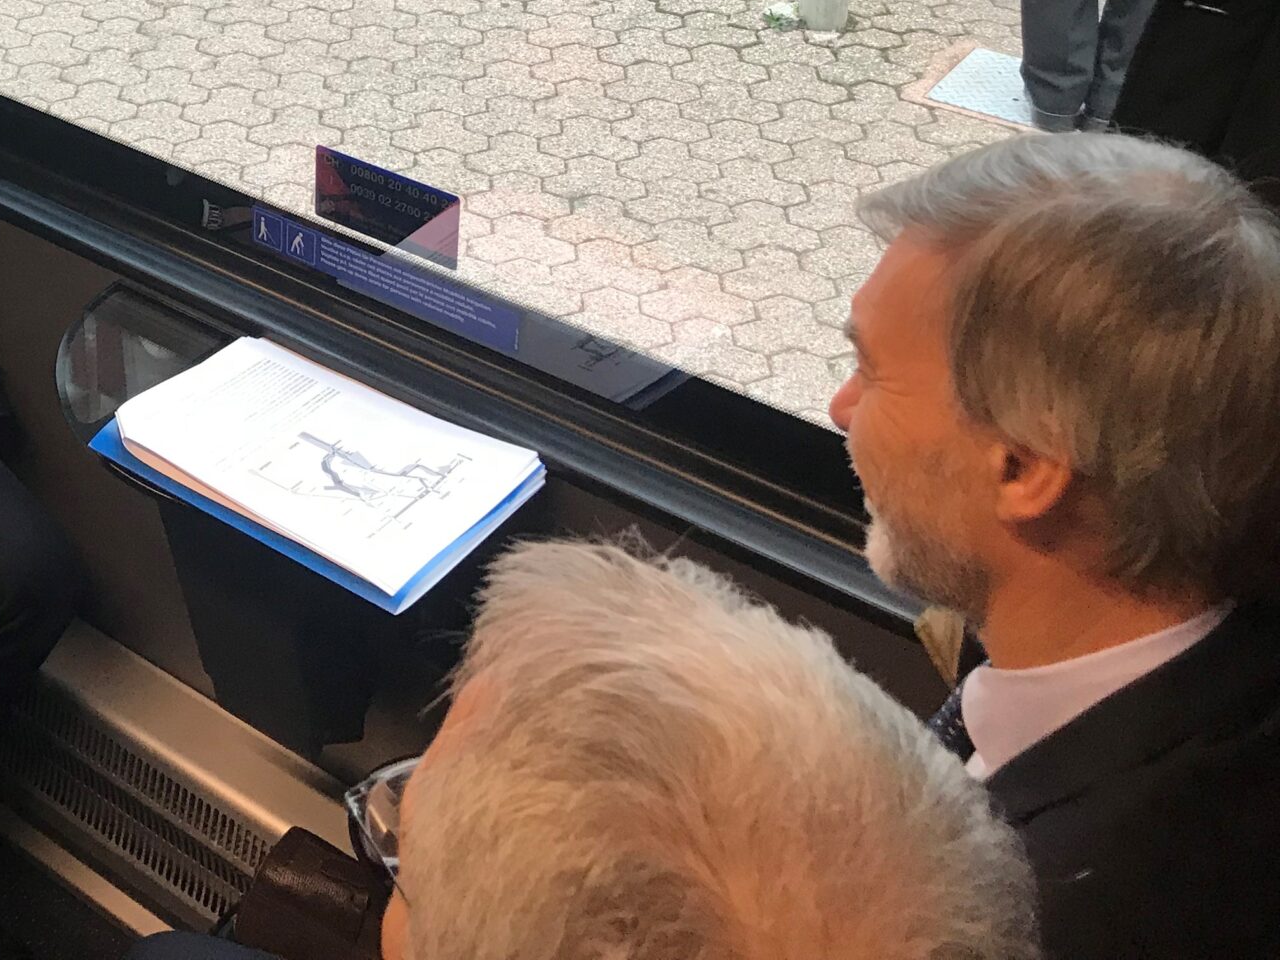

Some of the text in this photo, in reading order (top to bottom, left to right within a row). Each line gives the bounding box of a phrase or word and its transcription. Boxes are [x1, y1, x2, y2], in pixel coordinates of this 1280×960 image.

[350, 164, 385, 185] 00800
[388, 180, 402, 192] 20
[406, 186, 420, 199] 40
[423, 193, 438, 205] 40
[350, 183, 376, 201] 0039
[378, 194, 392, 207] 02
[395, 200, 421, 218] 2700
